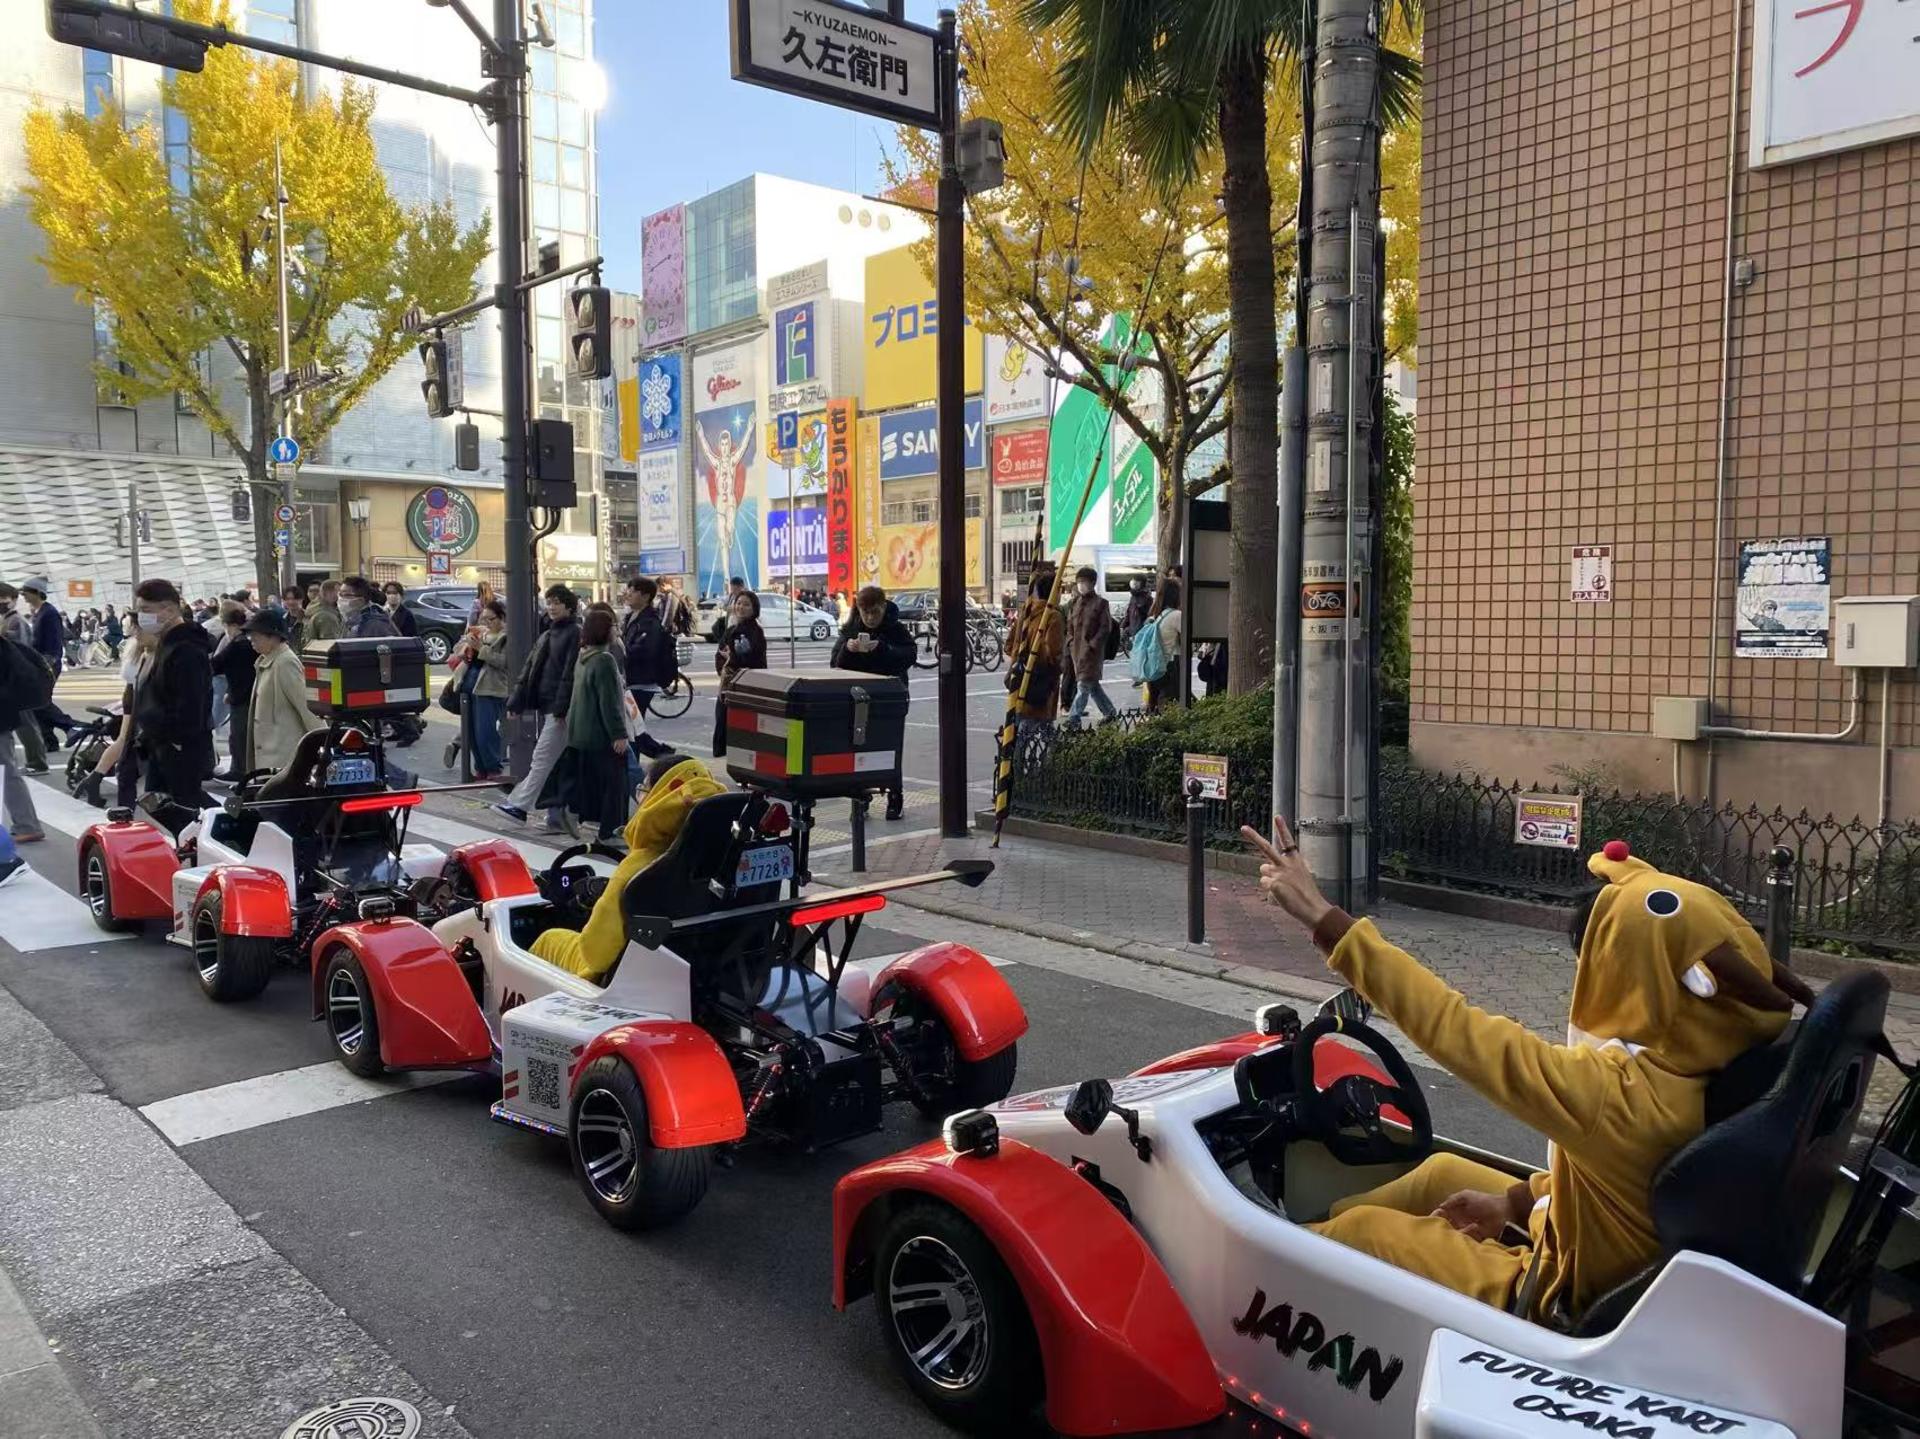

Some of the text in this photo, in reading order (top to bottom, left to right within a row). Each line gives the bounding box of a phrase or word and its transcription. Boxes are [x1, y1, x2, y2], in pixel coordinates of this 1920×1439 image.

[804, 9, 887, 45] KYUZAEMON
[782, 26, 909, 96] 久左衛門
[831, 407, 849, 598] もうかりまっ
[770, 522, 828, 559] CHNTAI
[1574, 591, 1607, 600] 立入禁止
[1308, 624, 1340, 634] 大阪市
[751, 862, 780, 881] 7728
[1232, 1287, 1403, 1402] JAPAN
[1458, 1350, 1746, 1436] FUTURE KART
[1512, 1393, 1657, 1439] OSAKA
